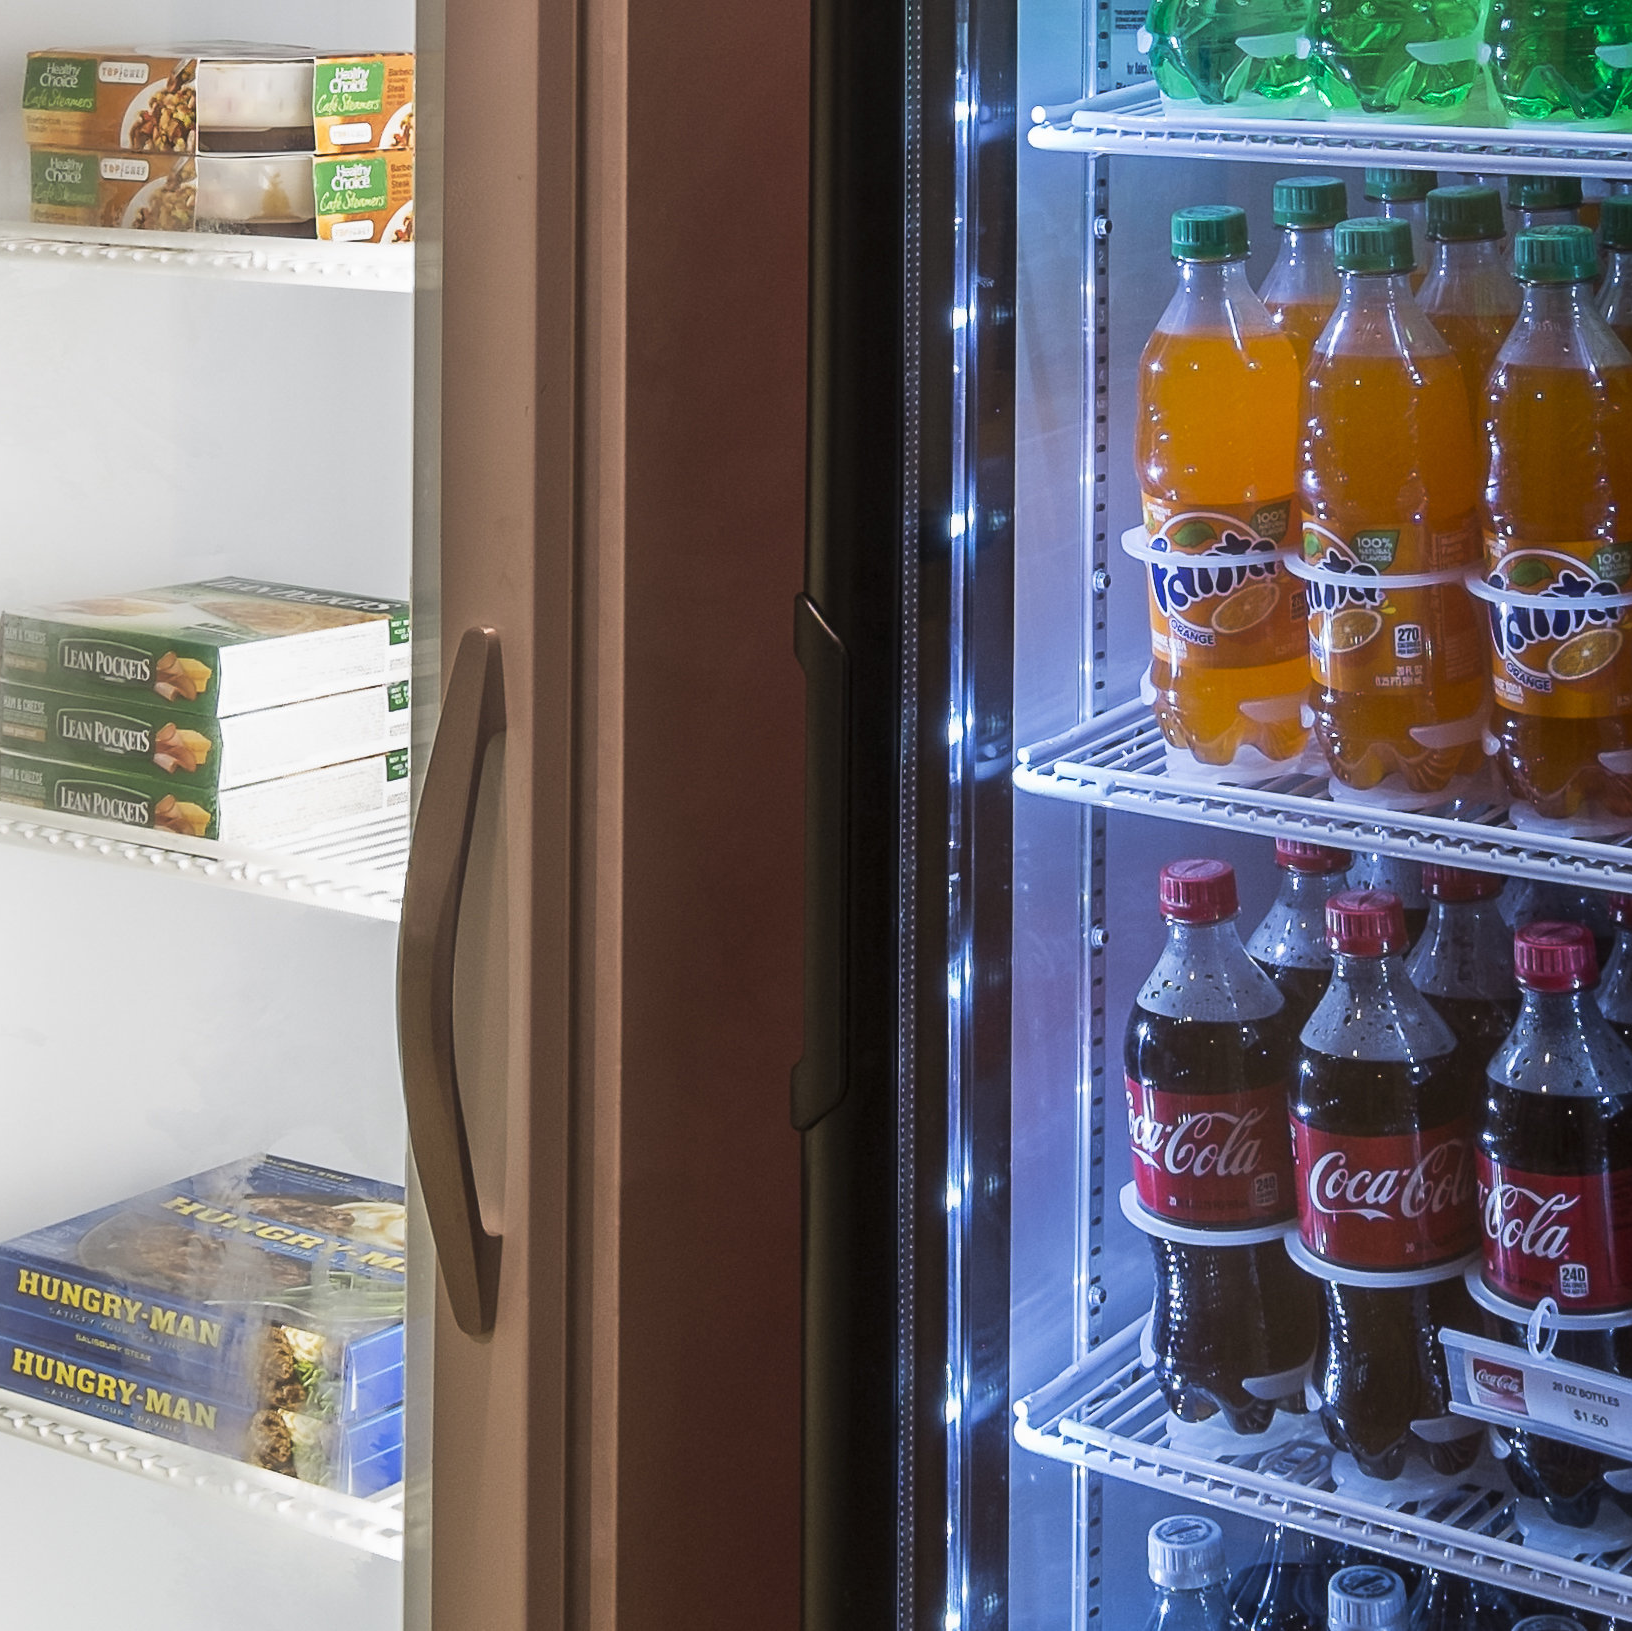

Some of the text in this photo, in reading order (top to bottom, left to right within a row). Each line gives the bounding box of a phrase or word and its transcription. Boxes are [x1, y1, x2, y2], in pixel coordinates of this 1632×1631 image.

[46, 62, 82, 77] Healthy
[101, 67, 119, 76] TOP
[335, 67, 369, 81] Healthy
[39, 72, 79, 88] Choice
[329, 78, 368, 94] Choice
[387, 84, 405, 93] Steak
[48, 88, 94, 109] Steamers
[338, 93, 380, 112] Steamers
[50, 157, 84, 170] Healthy
[103, 163, 120, 174] TOP
[335, 164, 372, 179] Healthy
[45, 168, 82, 184] Choice
[330, 174, 371, 191] Choice
[391, 180, 410, 189] Steak
[345, 189, 386, 210] Steamers
[1256, 509, 1286, 523] 100%
[1357, 537, 1393, 549] 100%
[1359, 548, 1392, 556] NATURAL
[1361, 554, 1392, 562] FLAVORS
[1596, 552, 1631, 565] 100%
[24, 629, 47, 645] CHEESE
[1170, 619, 1216, 646] ORANGE
[1397, 627, 1419, 641] 270
[64, 645, 94, 672] LEAN
[95, 650, 150, 682] POCKETS
[1506, 662, 1552, 692] ORANGE
[3, 695, 46, 714] HAM CHEESE
[62, 715, 93, 742] LEAN
[94, 720, 150, 752] POCKETS
[20, 768, 43, 786] CHEESE
[61, 786, 149, 825] LEAN POCKETS
[1256, 1176, 1276, 1191] 240
[1405, 1242, 1415, 1253] 20
[1562, 1267, 1586, 1281] 240
[17, 1269, 222, 1348] HUNGRY-MAN
[48, 1306, 96, 1325] SATISFY
[75, 1332, 152, 1363] SALISBURY STEAK
[12, 1347, 217, 1431] HUNGRY-MAN
[1476, 1369, 1519, 1393] Coca-Cola
[43, 1386, 124, 1416] SATISFY YOUR
[1552, 1382, 1620, 1407] 20 OZ BOTTLES
[1574, 1409, 1609, 1427] $1.50
